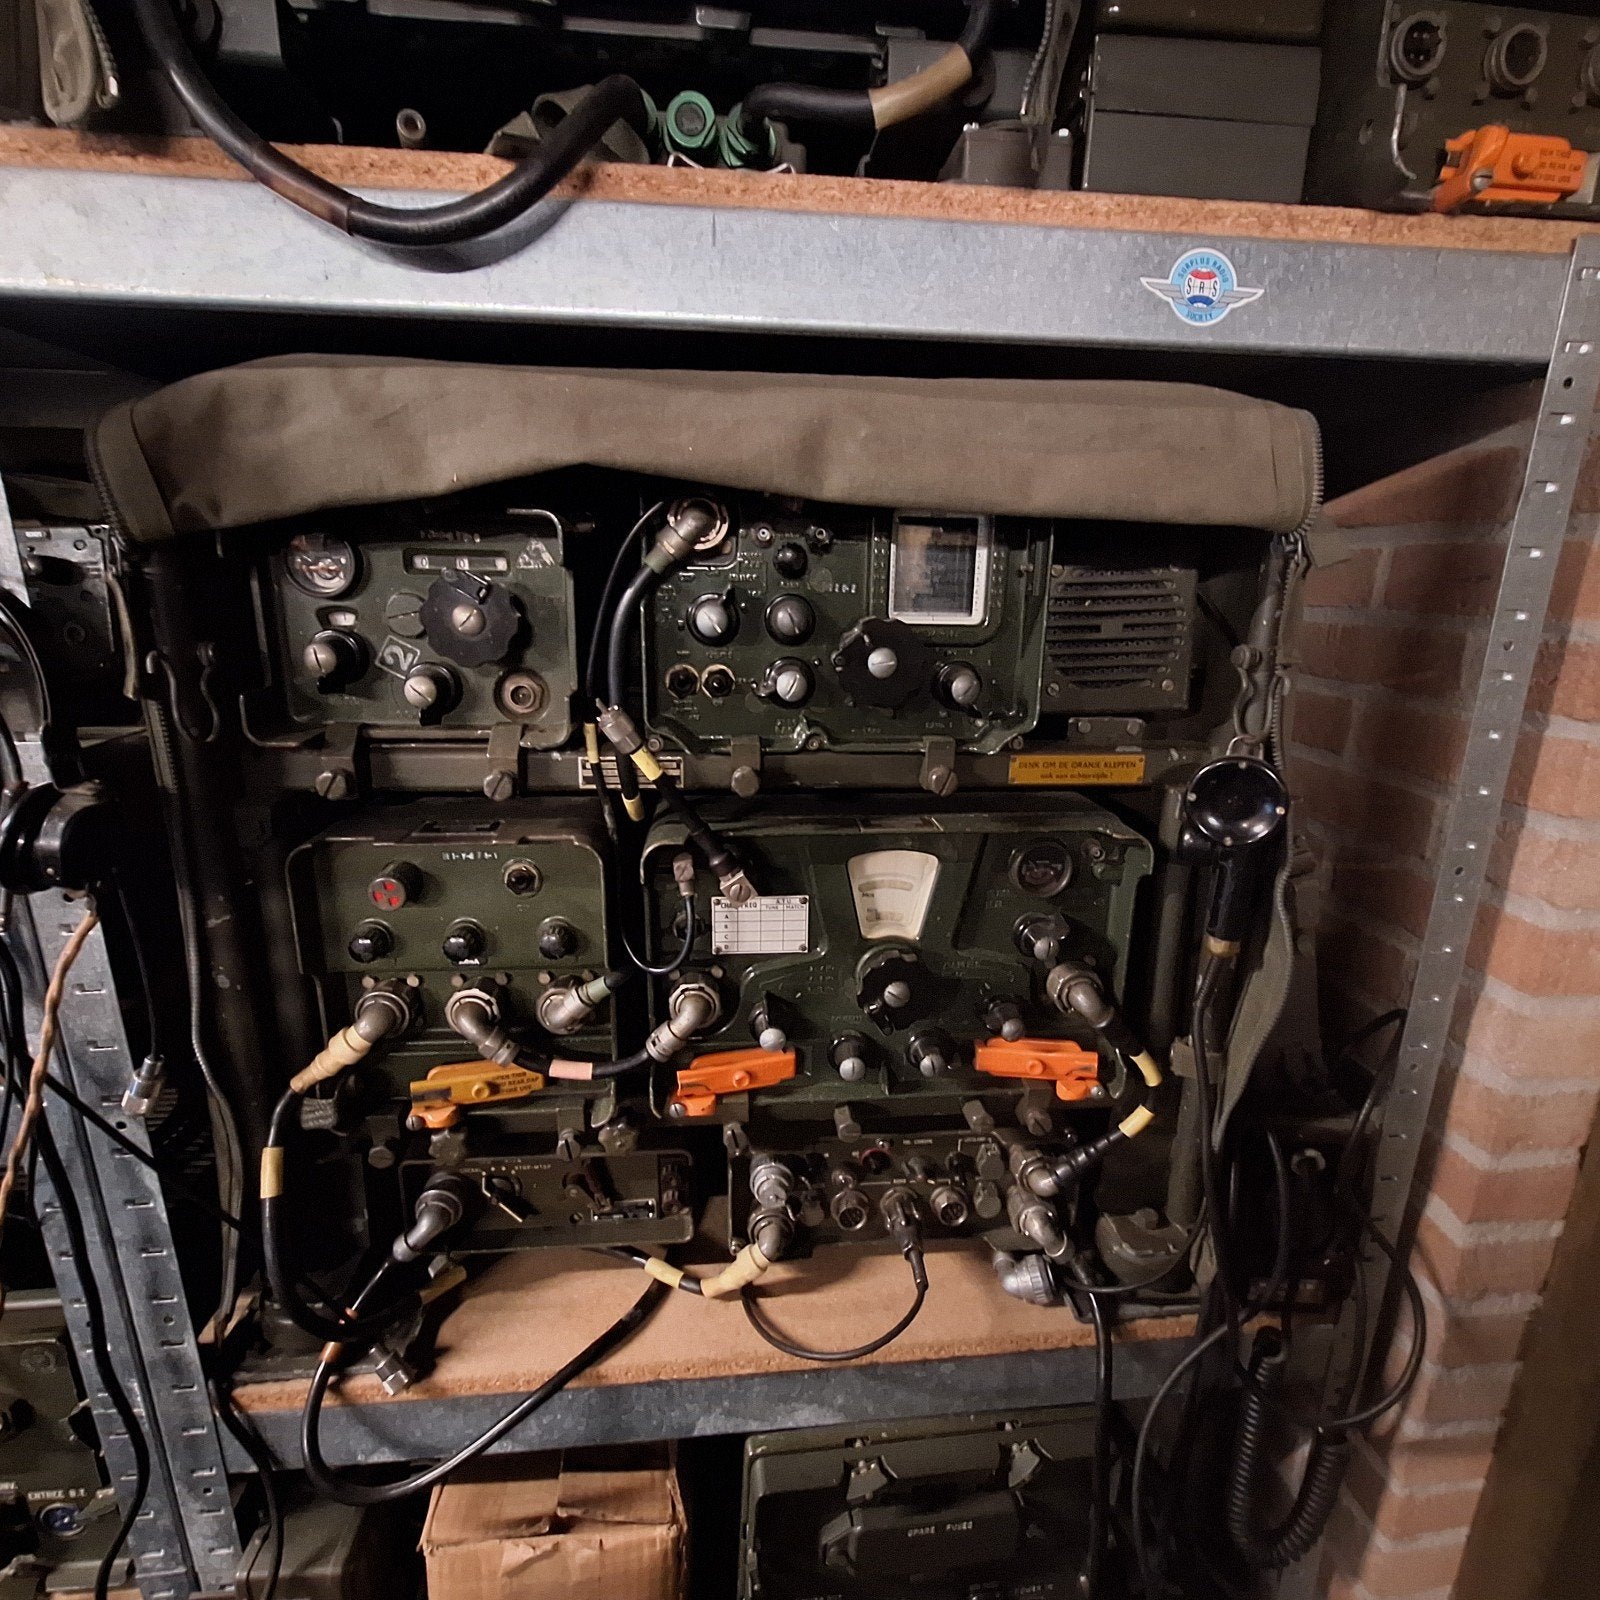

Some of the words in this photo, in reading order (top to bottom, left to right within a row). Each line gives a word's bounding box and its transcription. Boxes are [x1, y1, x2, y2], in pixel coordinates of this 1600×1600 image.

[1178, 257, 1210, 278] SURPLUS
[1212, 259, 1228, 282] RADIO
[1187, 310, 1213, 321] SOCIETY
[382, 644, 414, 671] 2
[1018, 760, 1040, 769] DENK
[1042, 760, 1056, 769] OM
[1058, 761, 1069, 769] DE
[1071, 761, 1100, 769] ORANJE
[1103, 761, 1137, 769] KLEPPEN
